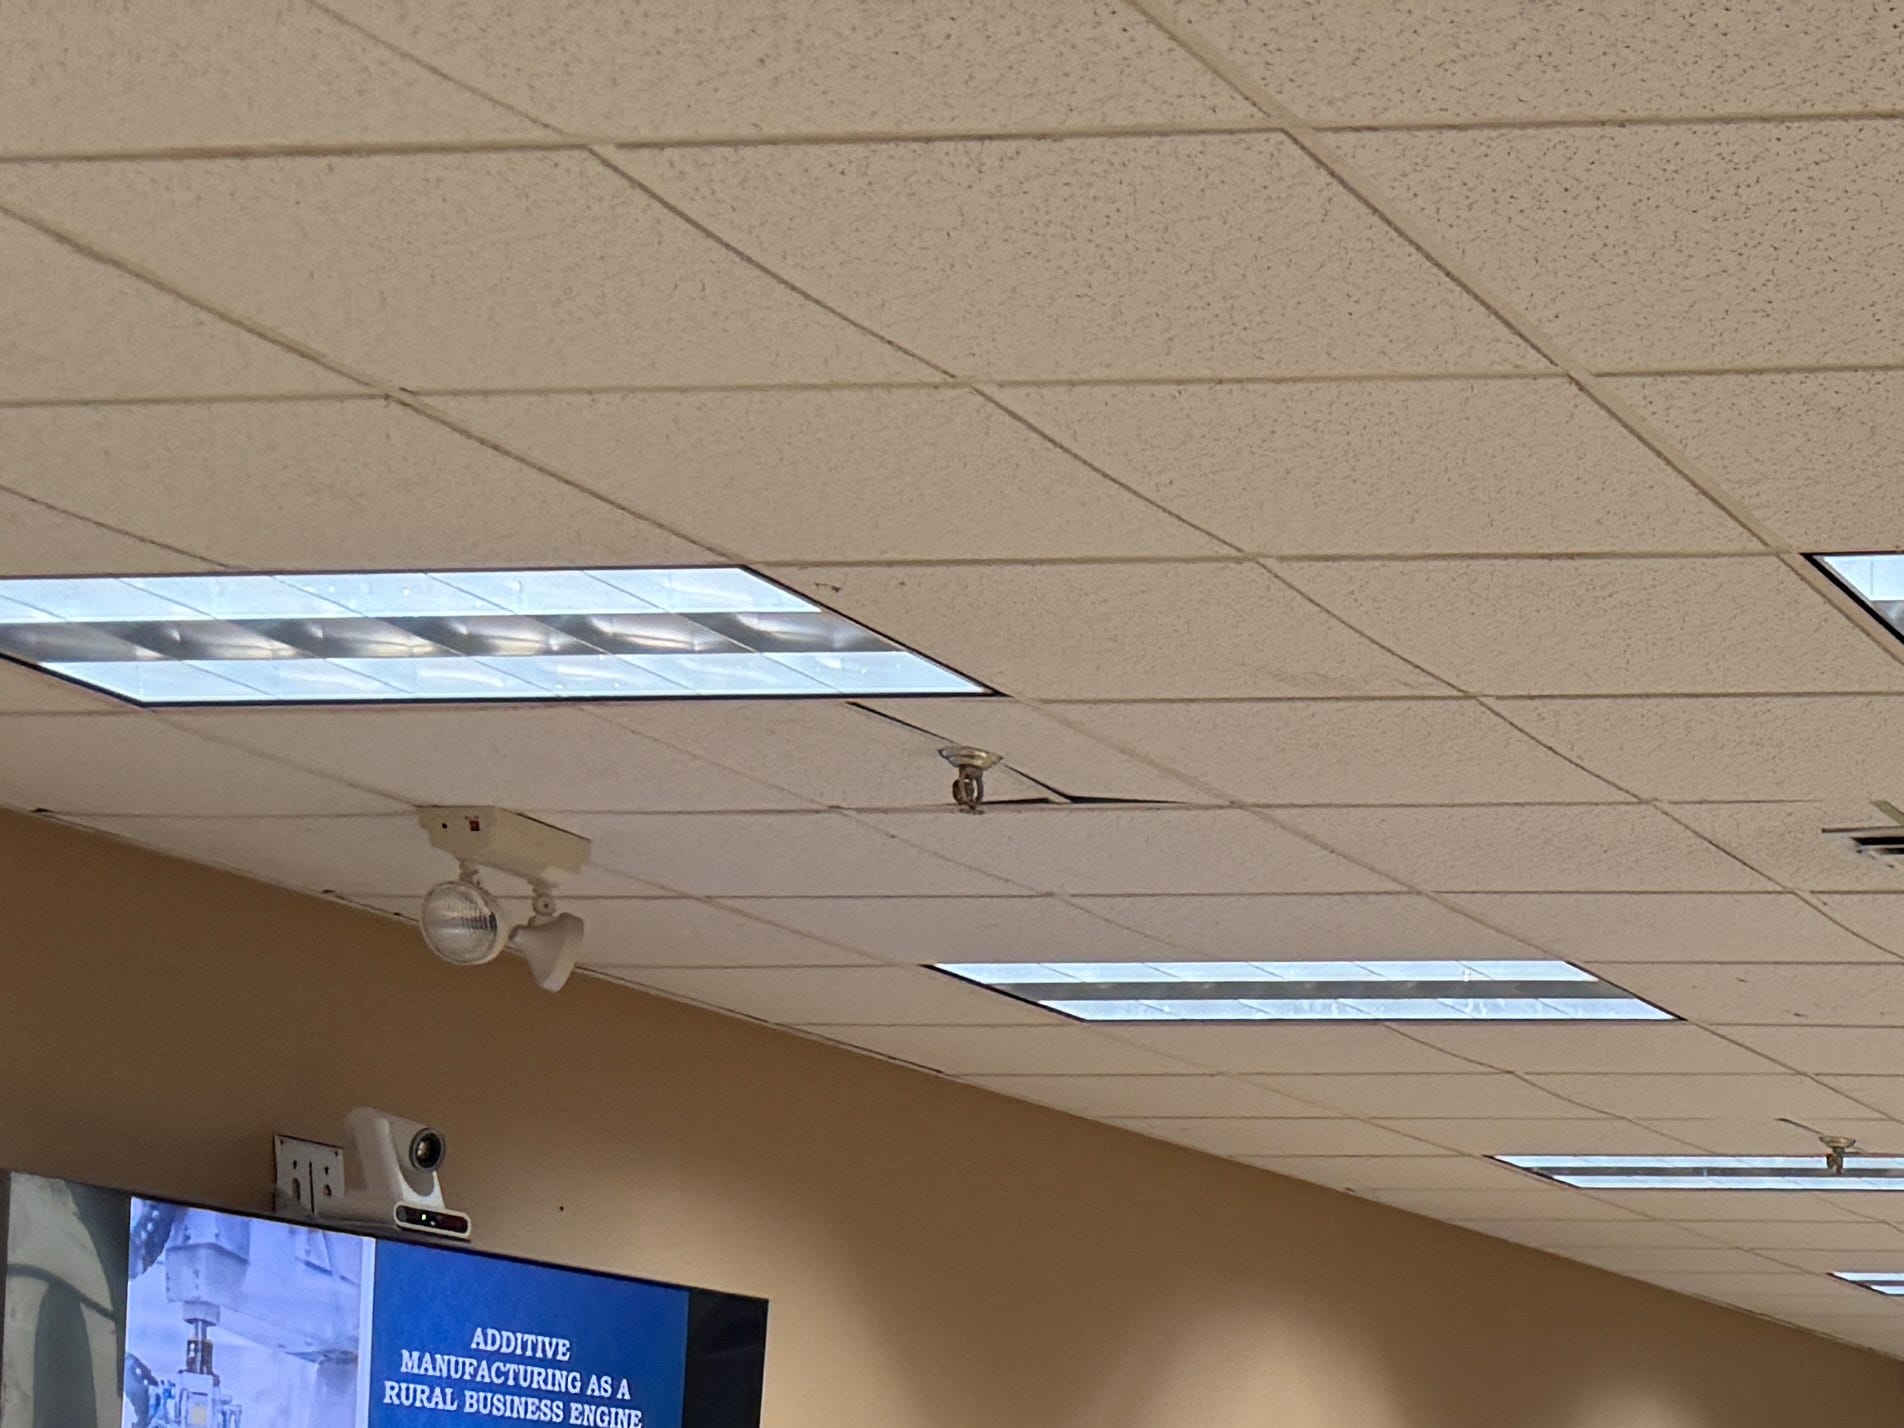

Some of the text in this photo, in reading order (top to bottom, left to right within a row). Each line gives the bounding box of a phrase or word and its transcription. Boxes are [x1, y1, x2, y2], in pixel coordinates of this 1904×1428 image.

[470, 1327, 571, 1362] ADDITIVE
[400, 1349, 632, 1400] MANUFACTURING AS A
[383, 1381, 458, 1412] RURAL
[463, 1390, 565, 1423] BUSINESS
